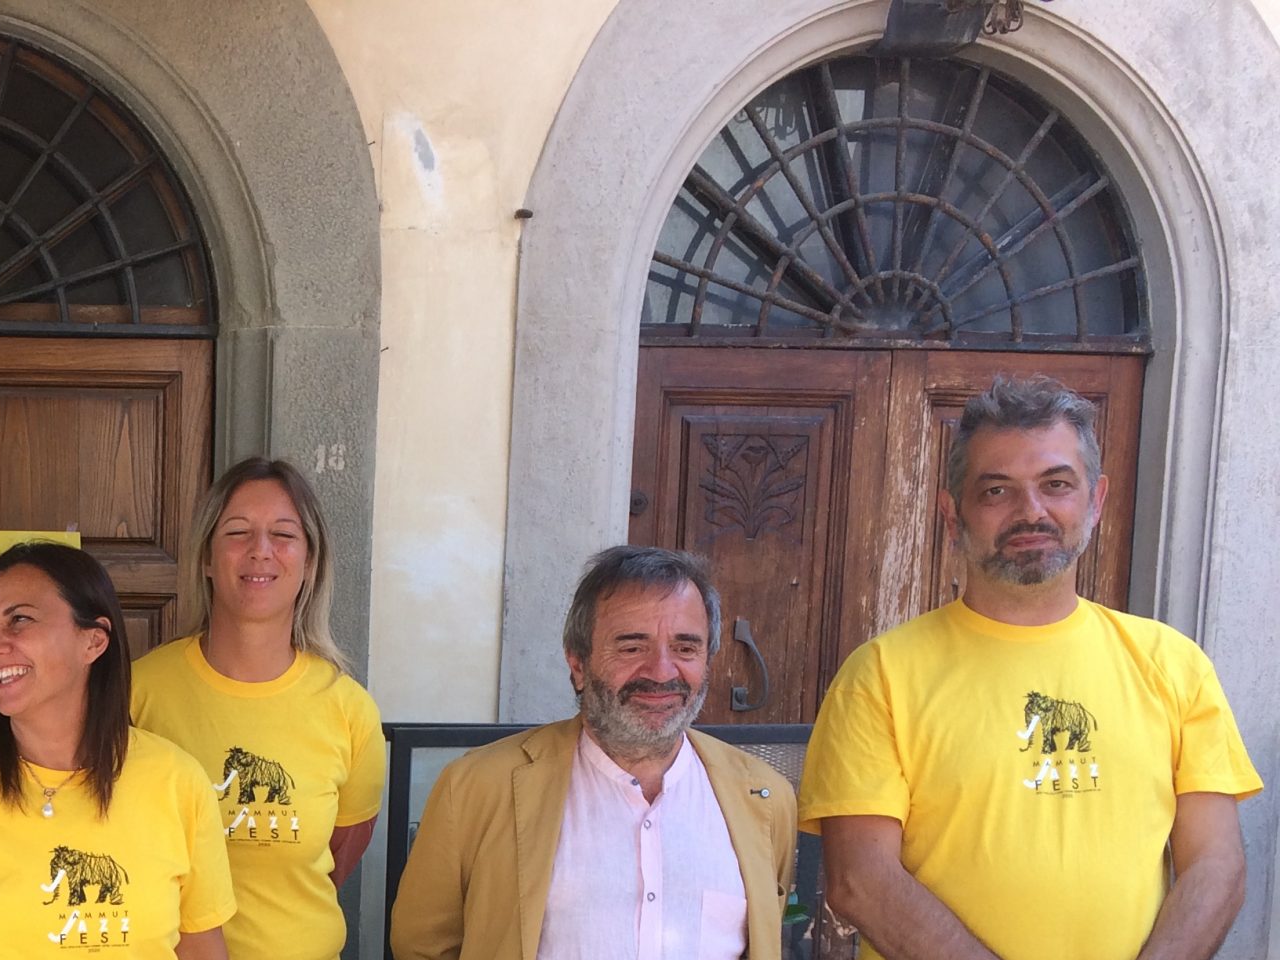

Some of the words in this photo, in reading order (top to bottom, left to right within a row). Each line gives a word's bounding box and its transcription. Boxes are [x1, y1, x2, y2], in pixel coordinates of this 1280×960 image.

[1033, 757, 1096, 767] MAMMUT
[1035, 776, 1098, 790] FEST
[229, 828, 299, 840] FEST
[59, 911, 128, 920] MAMMUT
[60, 932, 129, 945] FEST
